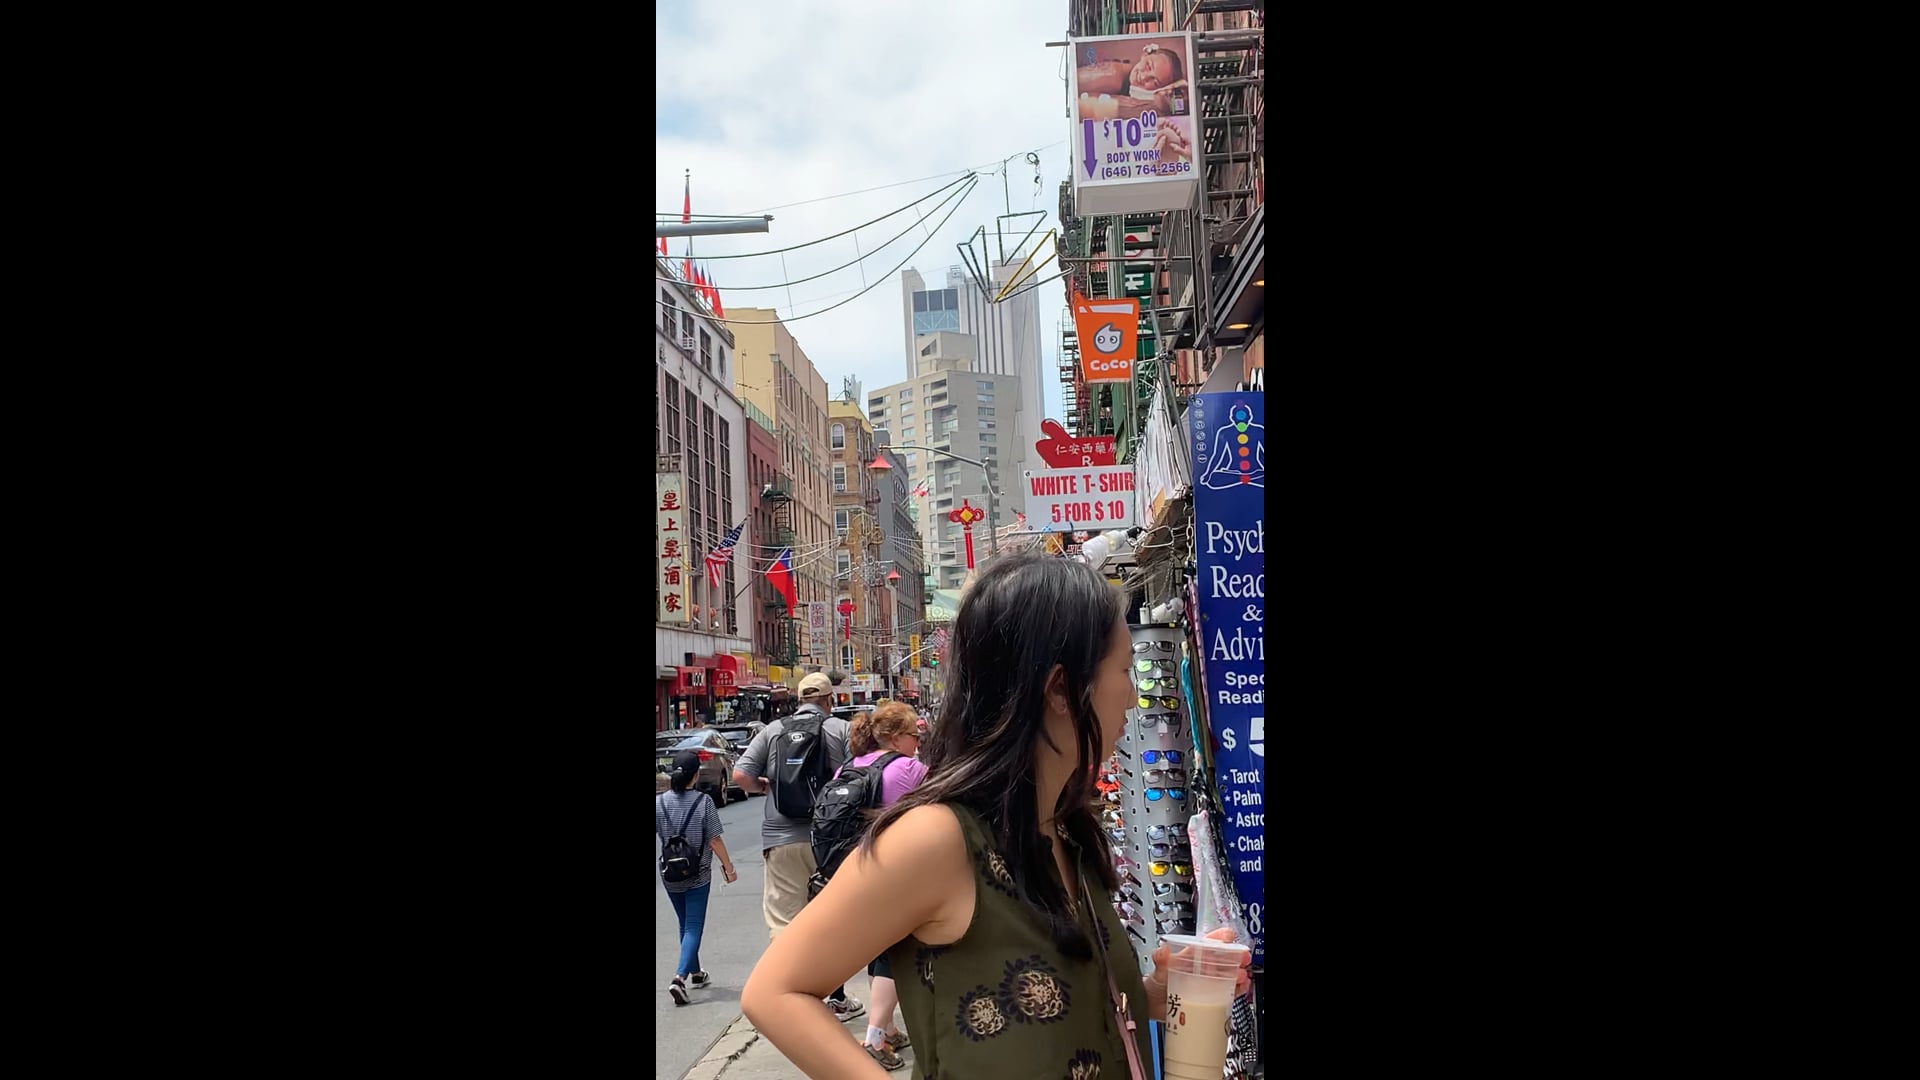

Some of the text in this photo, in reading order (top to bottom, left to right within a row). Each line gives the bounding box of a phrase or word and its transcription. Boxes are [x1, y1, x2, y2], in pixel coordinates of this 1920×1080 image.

[1107, 150, 1160, 164] BODY WORK
[1101, 162, 1191, 180] (646) 764-2566
[1031, 475, 1077, 496] WHITE
[1051, 504, 1061, 523] 5
[1064, 502, 1092, 522] FOR
[1242, 604, 1263, 622] &
[1230, 768, 1260, 784] Tarot
[1233, 790, 1262, 806] Palm
[1240, 855, 1262, 873] and
